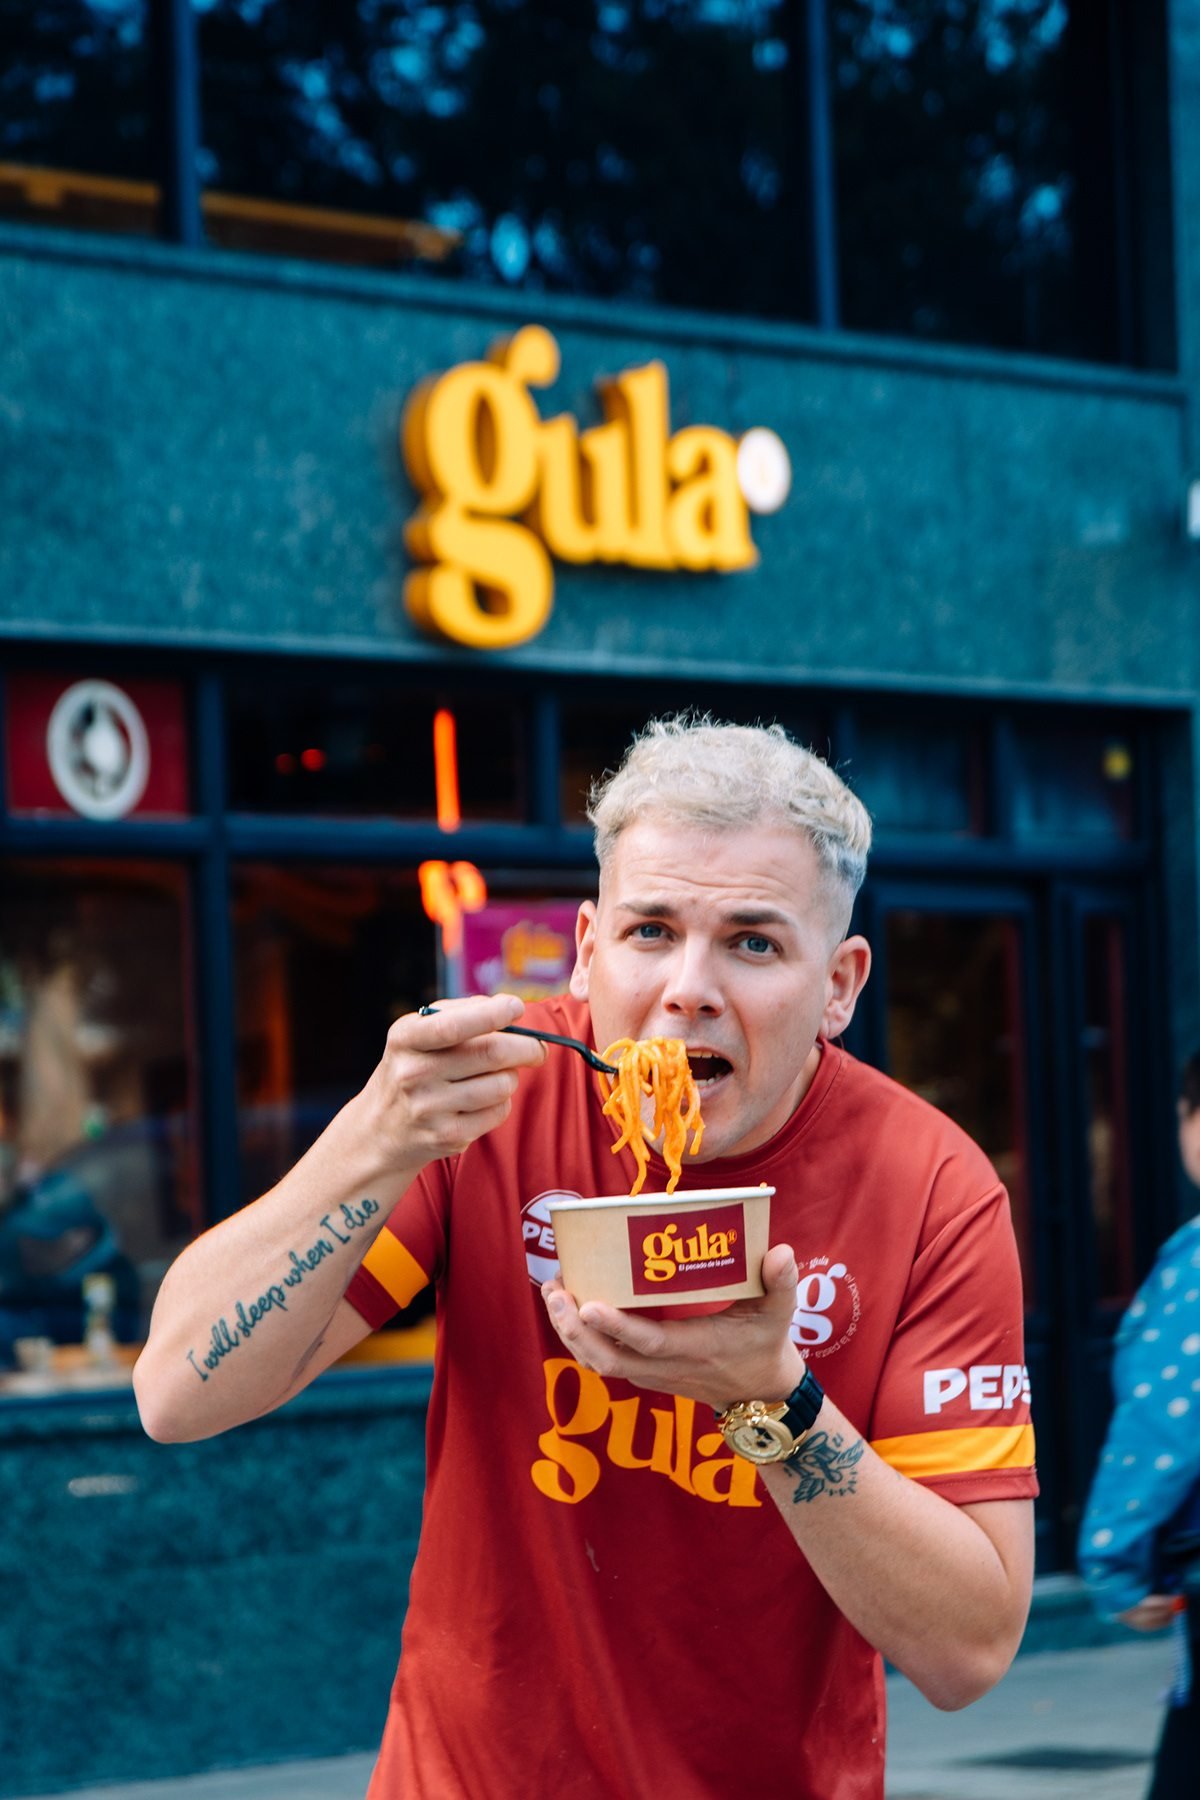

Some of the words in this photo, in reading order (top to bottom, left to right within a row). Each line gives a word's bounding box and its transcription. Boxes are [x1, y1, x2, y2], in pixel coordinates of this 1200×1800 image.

[405, 323, 760, 648] gula
[186, 1349, 208, 1382] I
[203, 1318, 241, 1371] will
[236, 1285, 288, 1337] sleep
[283, 1239, 335, 1288] when
[319, 1214, 351, 1245] I
[338, 1198, 381, 1231] die
[685, 1261, 707, 1272] pecado
[720, 1257, 735, 1267] pasta
[531, 1357, 763, 1508] gula
